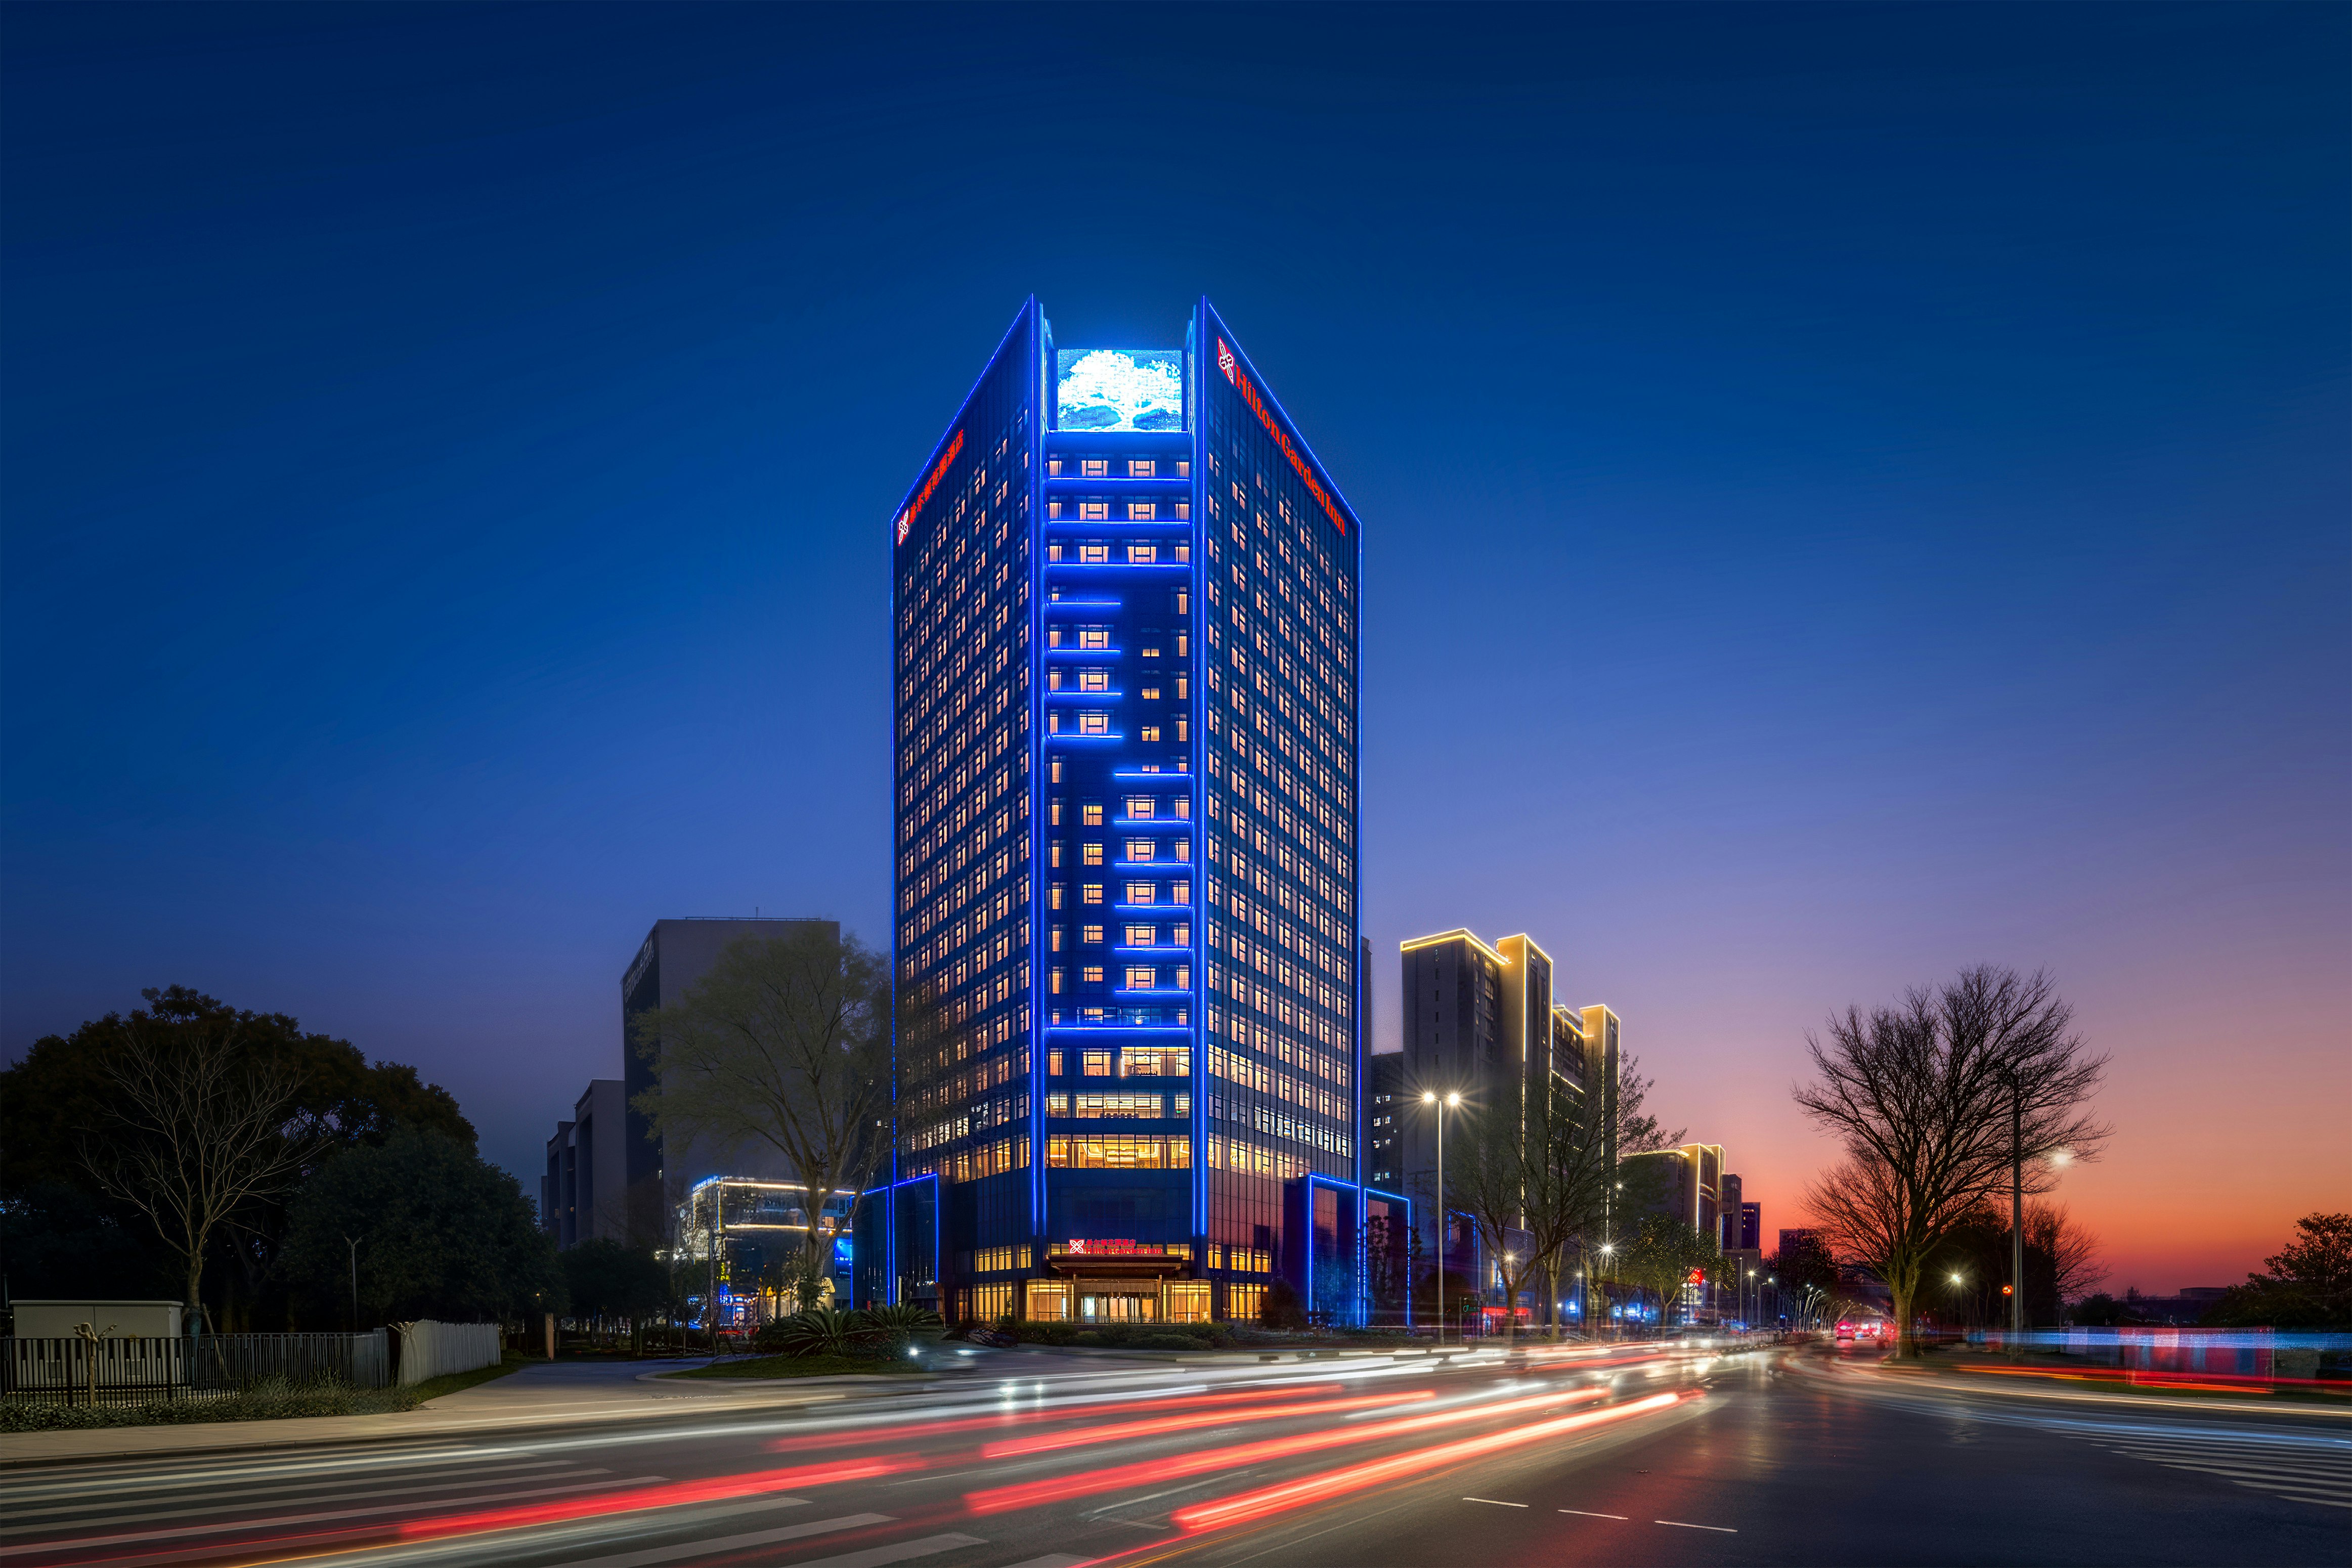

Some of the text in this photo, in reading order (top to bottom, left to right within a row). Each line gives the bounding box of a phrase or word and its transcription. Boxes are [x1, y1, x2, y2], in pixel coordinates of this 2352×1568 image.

[1236, 364, 1345, 536] Hilton Garden Inn
[1086, 1239, 1137, 1247] 希尔顿花园酒店
[1113, 1246, 1147, 1254] Garden
[1147, 1246, 1162, 1254] Inn
